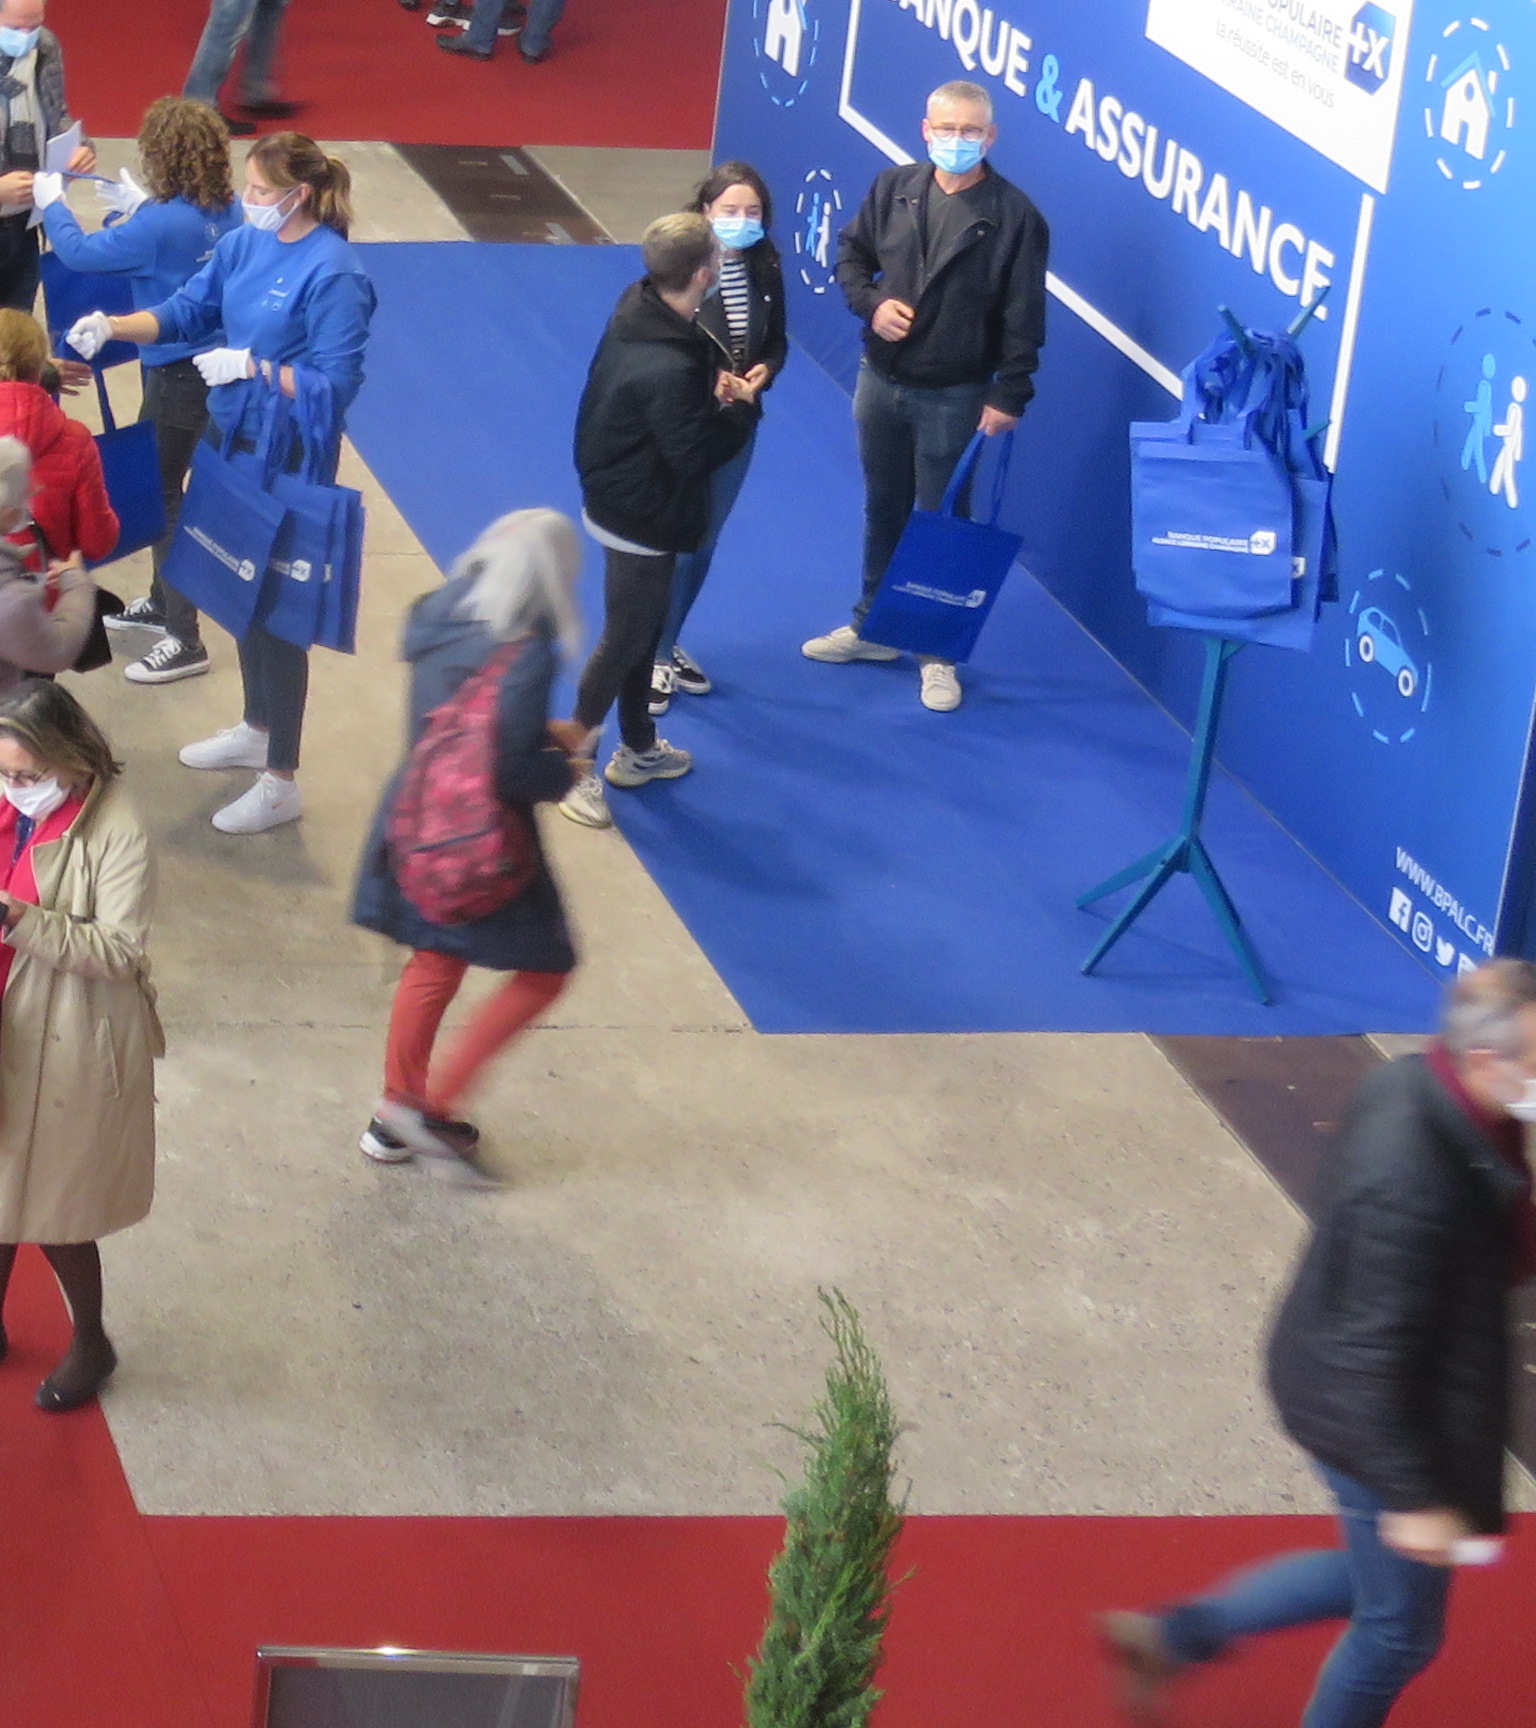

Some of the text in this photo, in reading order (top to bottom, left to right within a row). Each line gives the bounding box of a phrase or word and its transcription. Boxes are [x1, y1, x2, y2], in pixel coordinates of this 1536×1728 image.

[1216, 18, 1336, 108] la réussite est en vous
[1265, 14, 1340, 74] CHAMPAGNE
[1035, 53, 1064, 125] &
[1065, 77, 1336, 322] ASSURANCE
[1396, 846, 1494, 957] WWW.BPALC.FR
